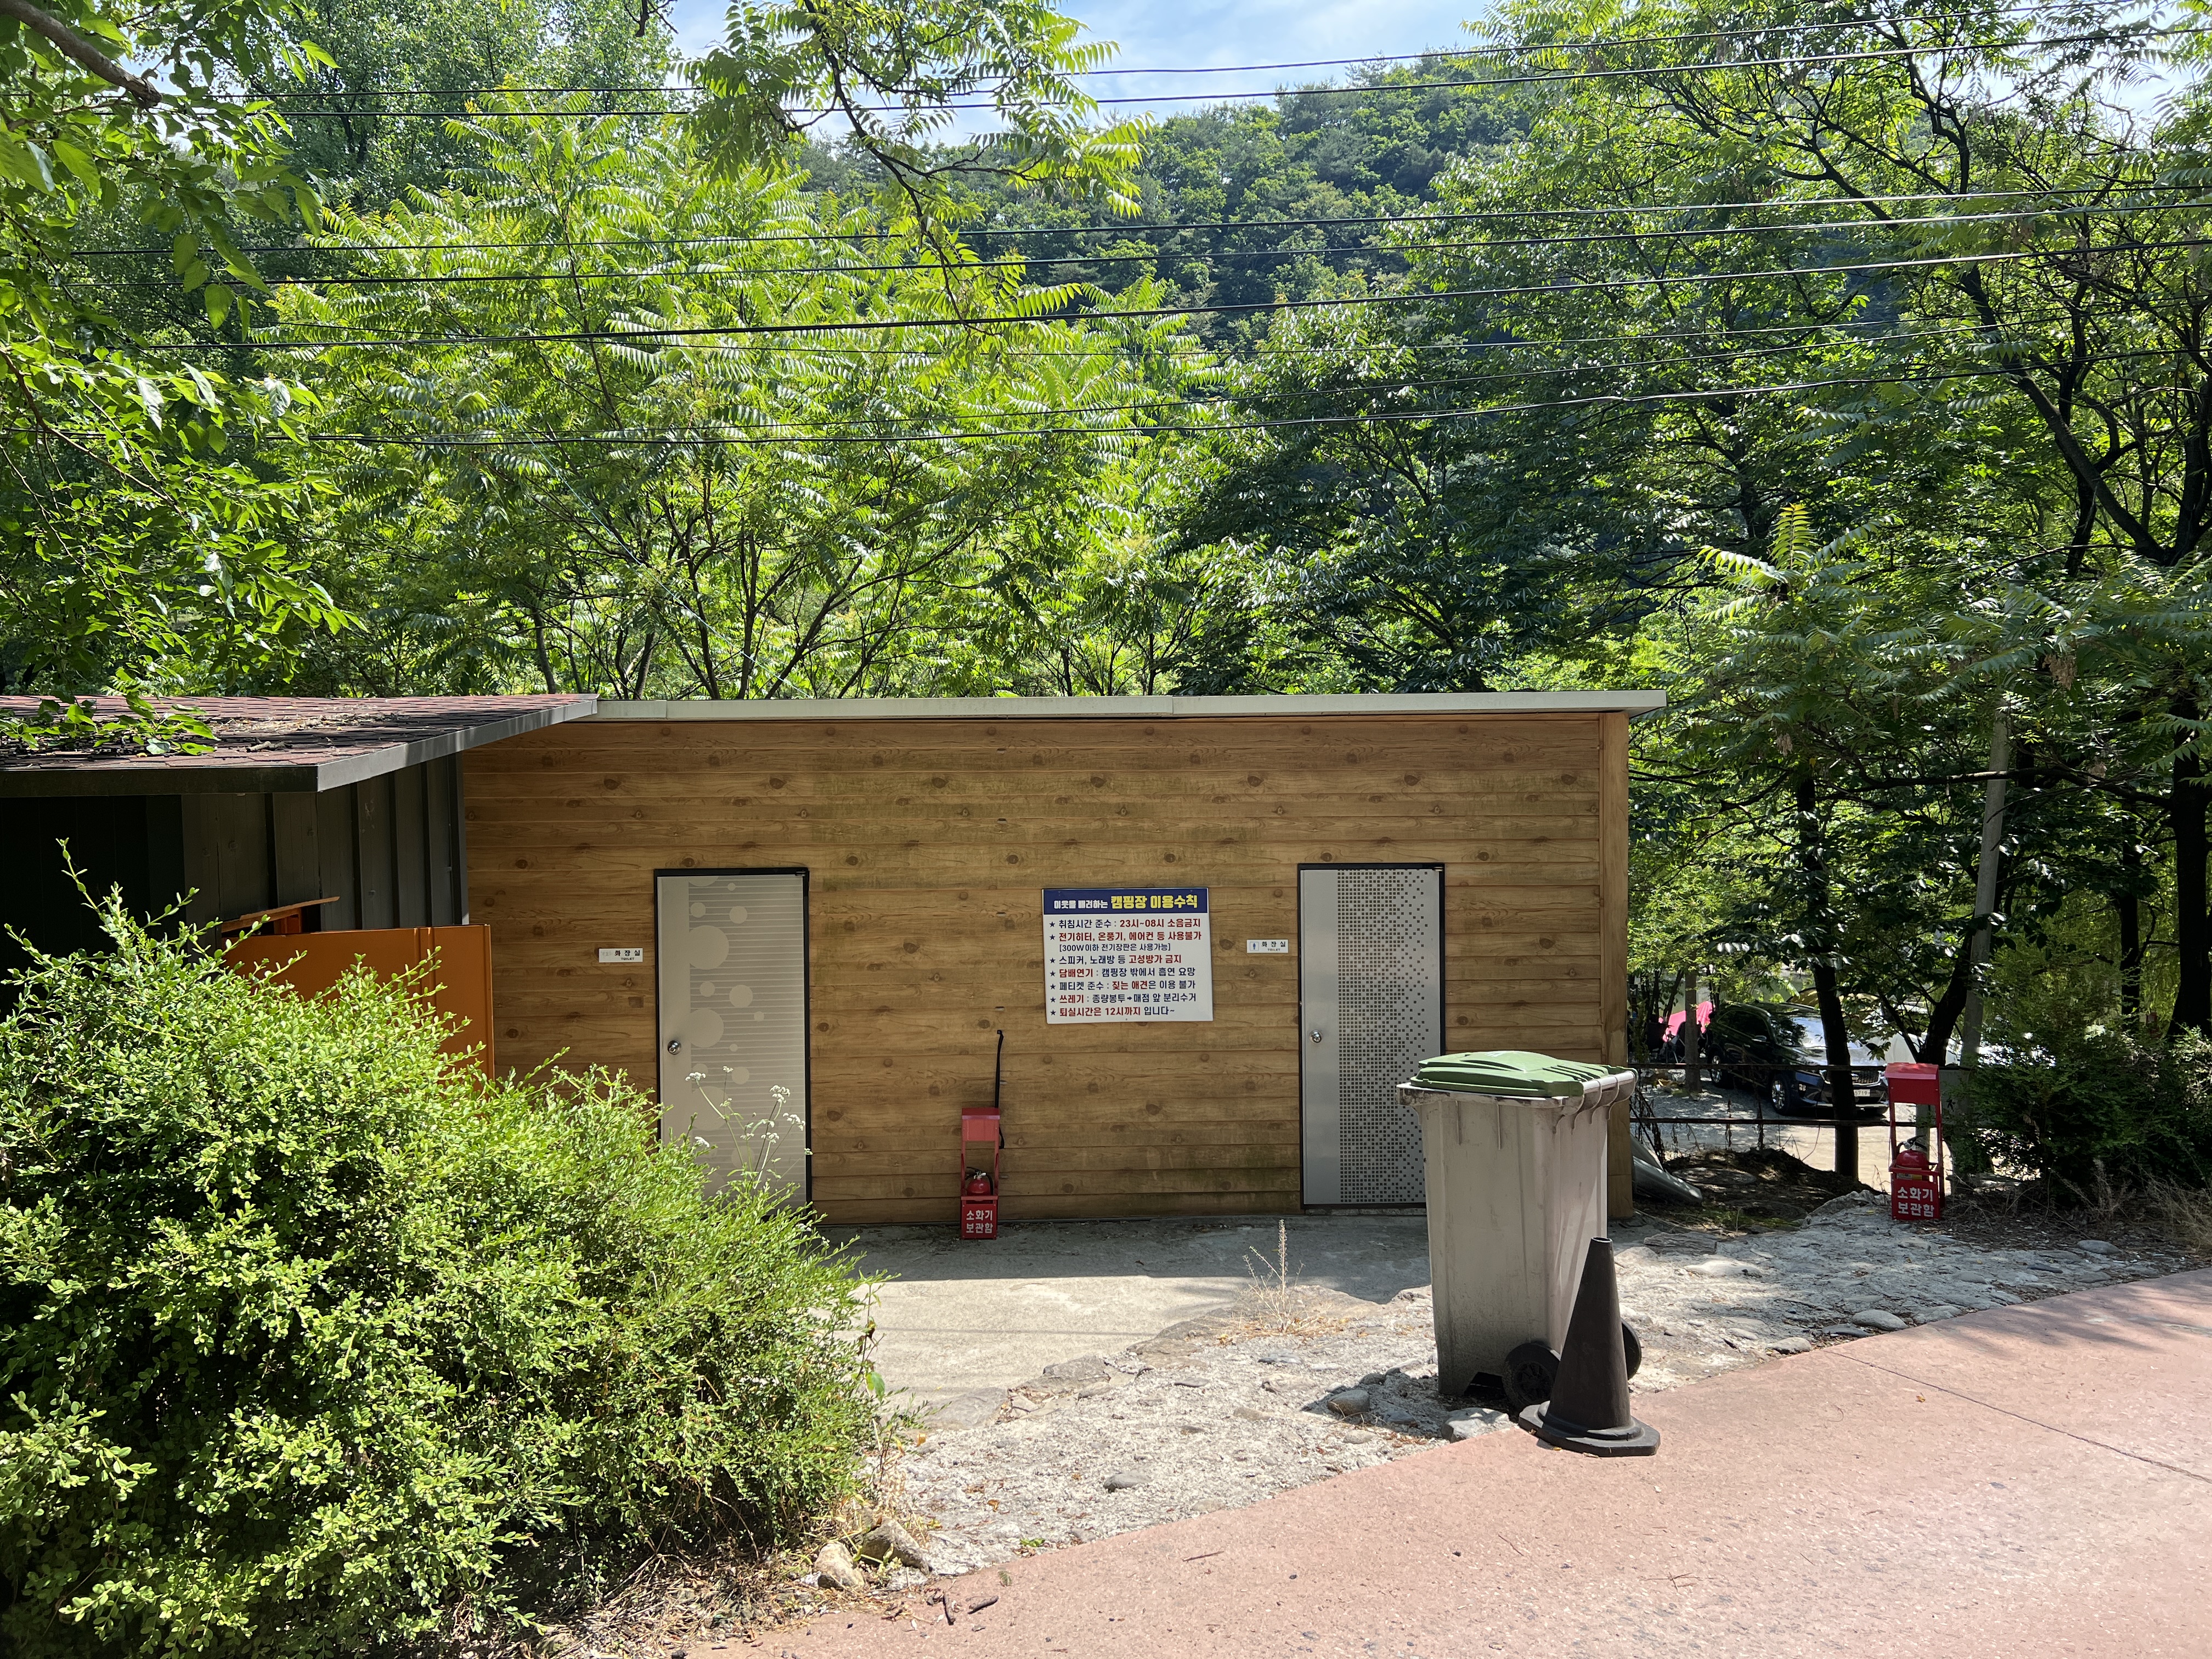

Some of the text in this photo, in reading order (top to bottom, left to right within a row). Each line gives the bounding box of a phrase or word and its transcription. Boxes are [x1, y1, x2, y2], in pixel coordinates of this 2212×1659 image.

[1054, 894, 1198, 909] 이웃을 배려하는 캠핑장 이용수칙
[1059, 919, 1092, 929] 취침시간
[1095, 919, 1111, 928] 준수
[1120, 918, 1164, 928] 23시~08시
[1167, 918, 1200, 927] 소음금지
[1059, 932, 1095, 941] 전기히터,
[1129, 931, 1154, 940] 에어컨
[1157, 931, 1165, 940] 등
[1168, 931, 1201, 940] 사용불가
[1101, 943, 1137, 951] 전기장판은
[1139, 943, 1171, 951] 사용가능]
[1059, 954, 1182, 965] 스피커, 노래방 등 고성방가 금지
[1059, 968, 1093, 978] 담배연기
[1102, 968, 1127, 977] 캠핑장
[1130, 967, 1155, 977] 밖에서
[1158, 967, 1175, 977] 흡연
[1178, 967, 1195, 976] 요망
[1059, 981, 1085, 991] 페티켓
[1087, 981, 1104, 990] 준수
[1111, 981, 1128, 990] 짖는
[1131, 980, 1156, 990] 애견은
[1159, 980, 1176, 989] 이용
[1178, 980, 1196, 989] 불가
[1059, 994, 1084, 1003] 쓰레기
[1153, 993, 1161, 1002] 앞
[1163, 992, 1197, 1002] 분리수거
[1059, 1007, 1102, 1017] 퇴실시간은
[1105, 1006, 1141, 1016] 12시까지
[1897, 1187, 1933, 1202] 소화기
[1898, 1201, 1934, 1217] 보관함
[966, 1210, 993, 1221] 소화기
[966, 1223, 994, 1234] 보관함
